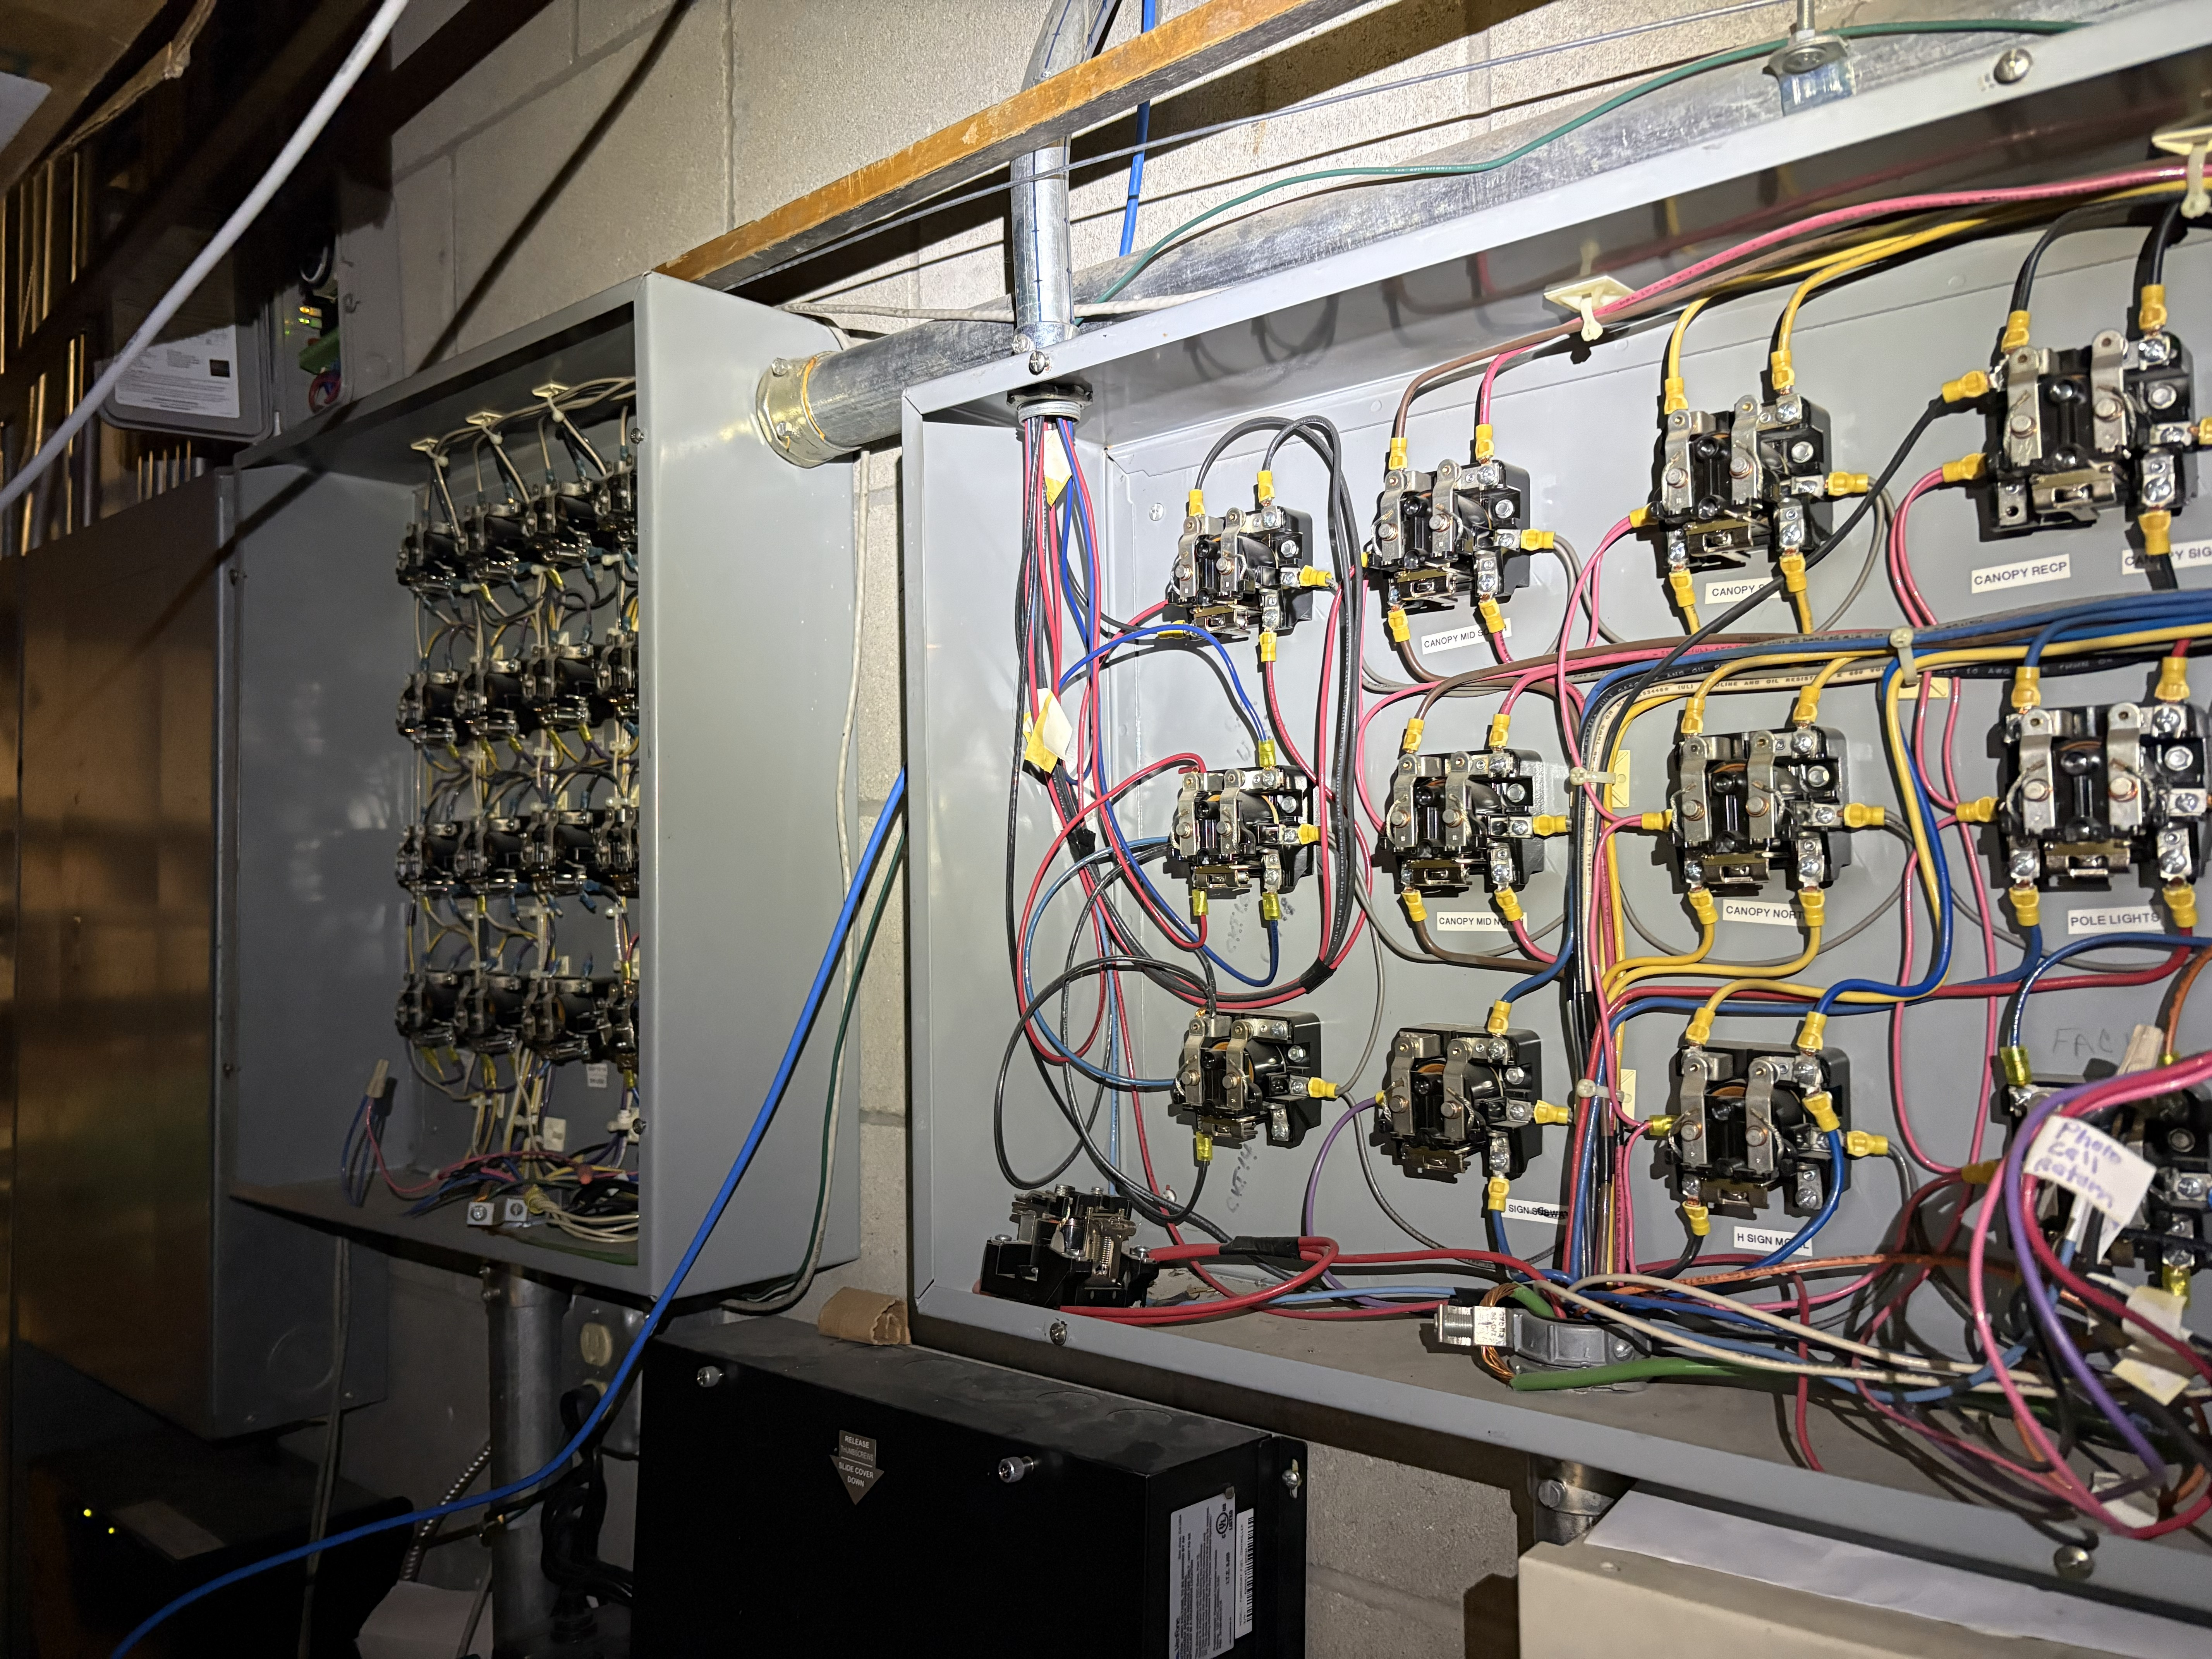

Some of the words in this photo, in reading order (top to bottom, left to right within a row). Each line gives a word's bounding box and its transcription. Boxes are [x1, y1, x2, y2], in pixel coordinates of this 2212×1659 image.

[1974, 567, 2028, 586] CANOPY
[2032, 561, 2067, 576] RECP
[1712, 584, 1755, 596] CANOPY
[1424, 635, 1458, 648] CANOPY
[1460, 631, 1475, 641] MID
[1726, 905, 1770, 917] CANOPY
[1773, 909, 1805, 920] NORT
[2070, 915, 2106, 927] POLE
[2109, 912, 2160, 925] LIGHTS
[2052, 1027, 2129, 1056] FAC
[1508, 1204, 1529, 1214] SIGN
[1737, 1233, 1744, 1242] H
[1747, 1234, 1772, 1244] SIGN
[845, 1435, 870, 1448] RELEASE
[840, 1445, 874, 1461] THUMBSCREWS
[839, 1462, 854, 1473] SLIDE
[855, 1467, 874, 1479] COVER
[847, 1475, 865, 1487] DOWN
